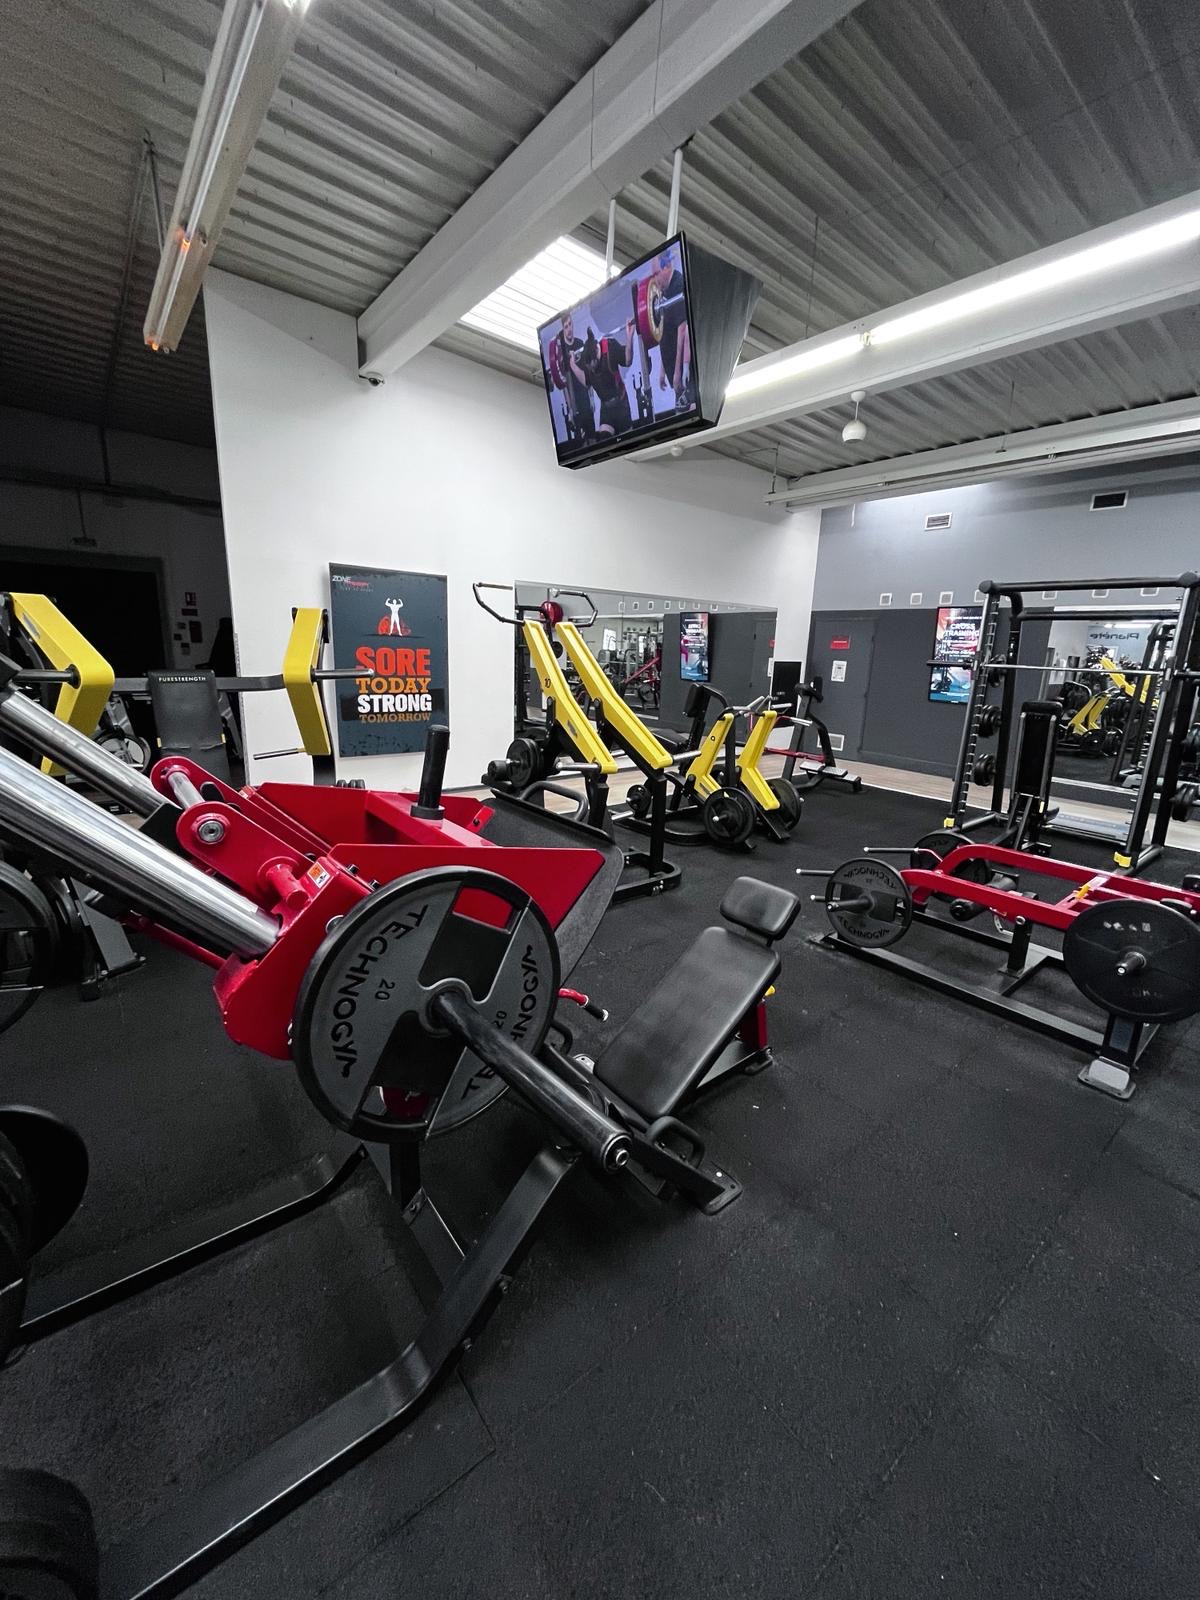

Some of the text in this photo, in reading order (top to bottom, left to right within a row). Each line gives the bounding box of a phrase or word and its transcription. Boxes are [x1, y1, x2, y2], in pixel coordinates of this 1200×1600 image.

[355, 646, 431, 676] SORE
[355, 677, 431, 694] TODAY
[357, 693, 432, 713] STRONG
[359, 712, 431, 723] TOMORROW
[330, 904, 429, 1078] TECHNOGYM
[375, 978, 395, 1001] 20
